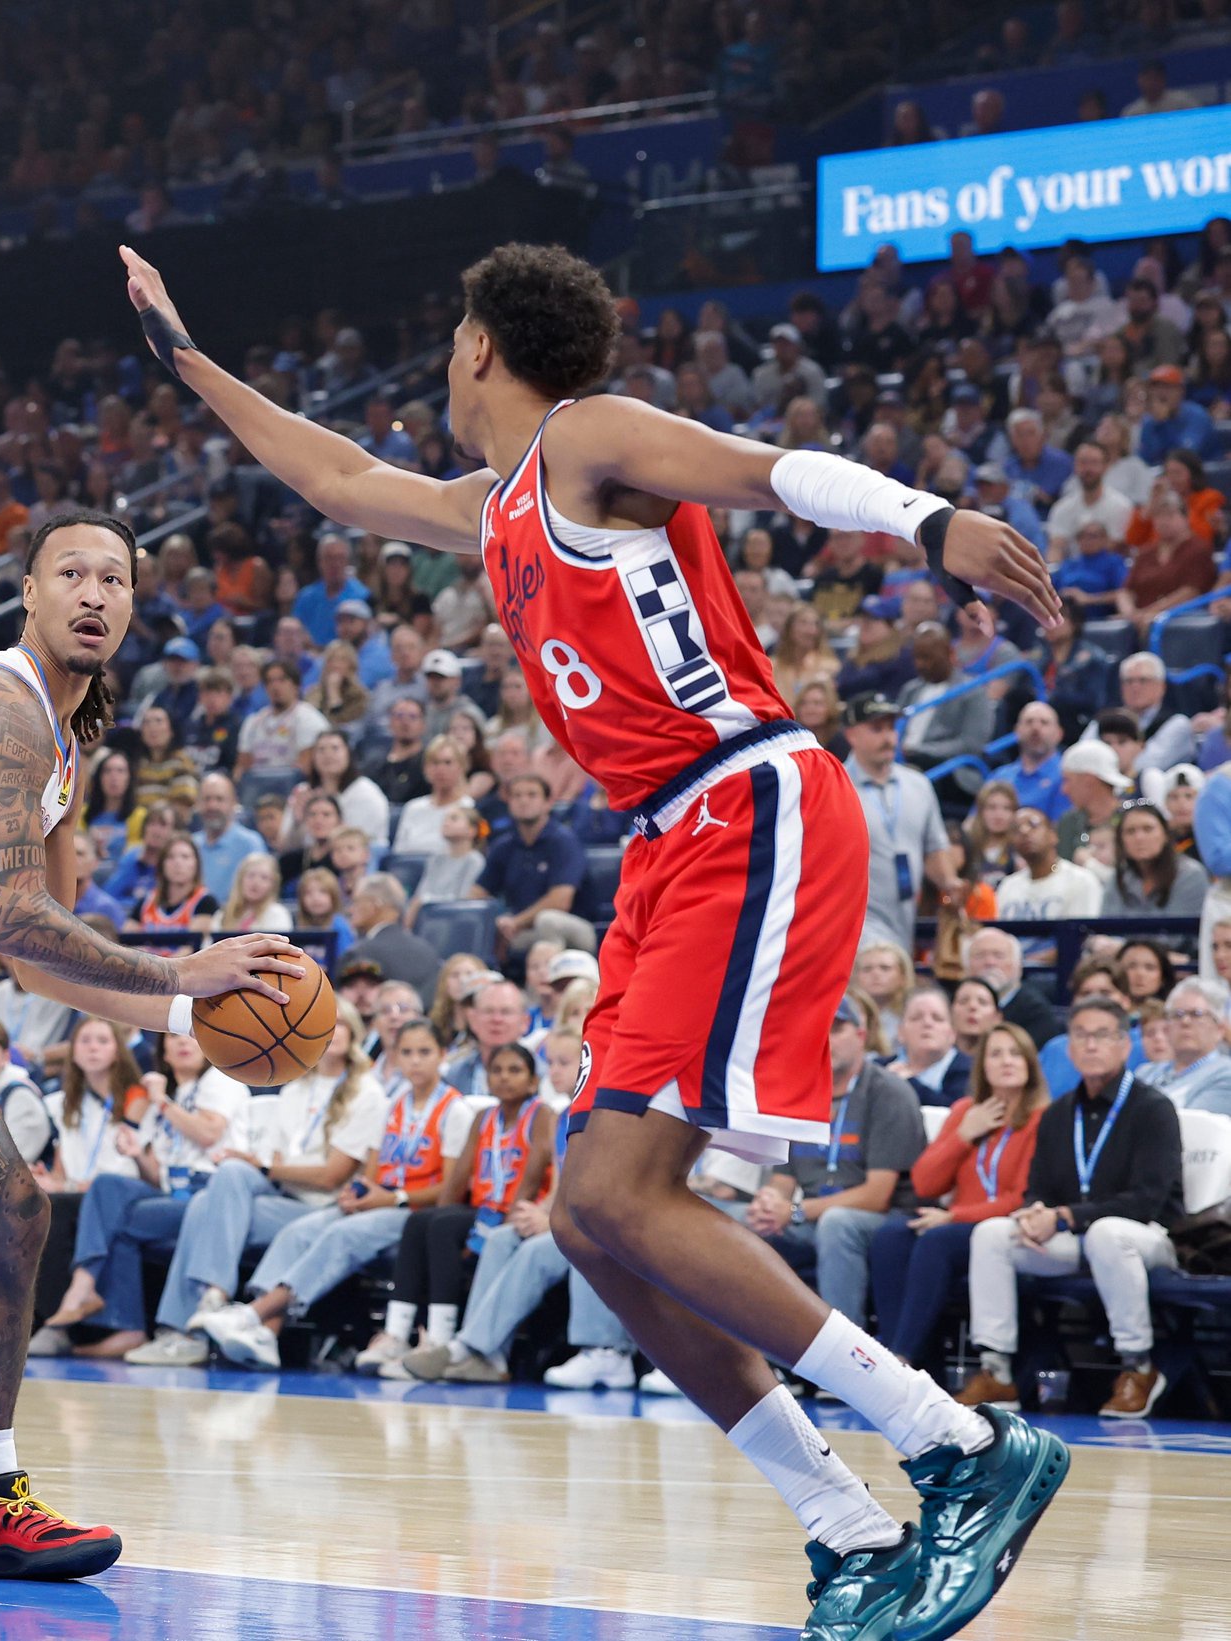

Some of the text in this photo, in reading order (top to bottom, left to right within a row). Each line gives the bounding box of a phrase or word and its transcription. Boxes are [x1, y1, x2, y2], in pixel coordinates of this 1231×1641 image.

[842, 184, 950, 237] Fans
[955, 164, 1015, 223] of
[1015, 165, 1132, 232] your
[540, 638, 602, 710] 8
[5, 818, 20, 834] 23
